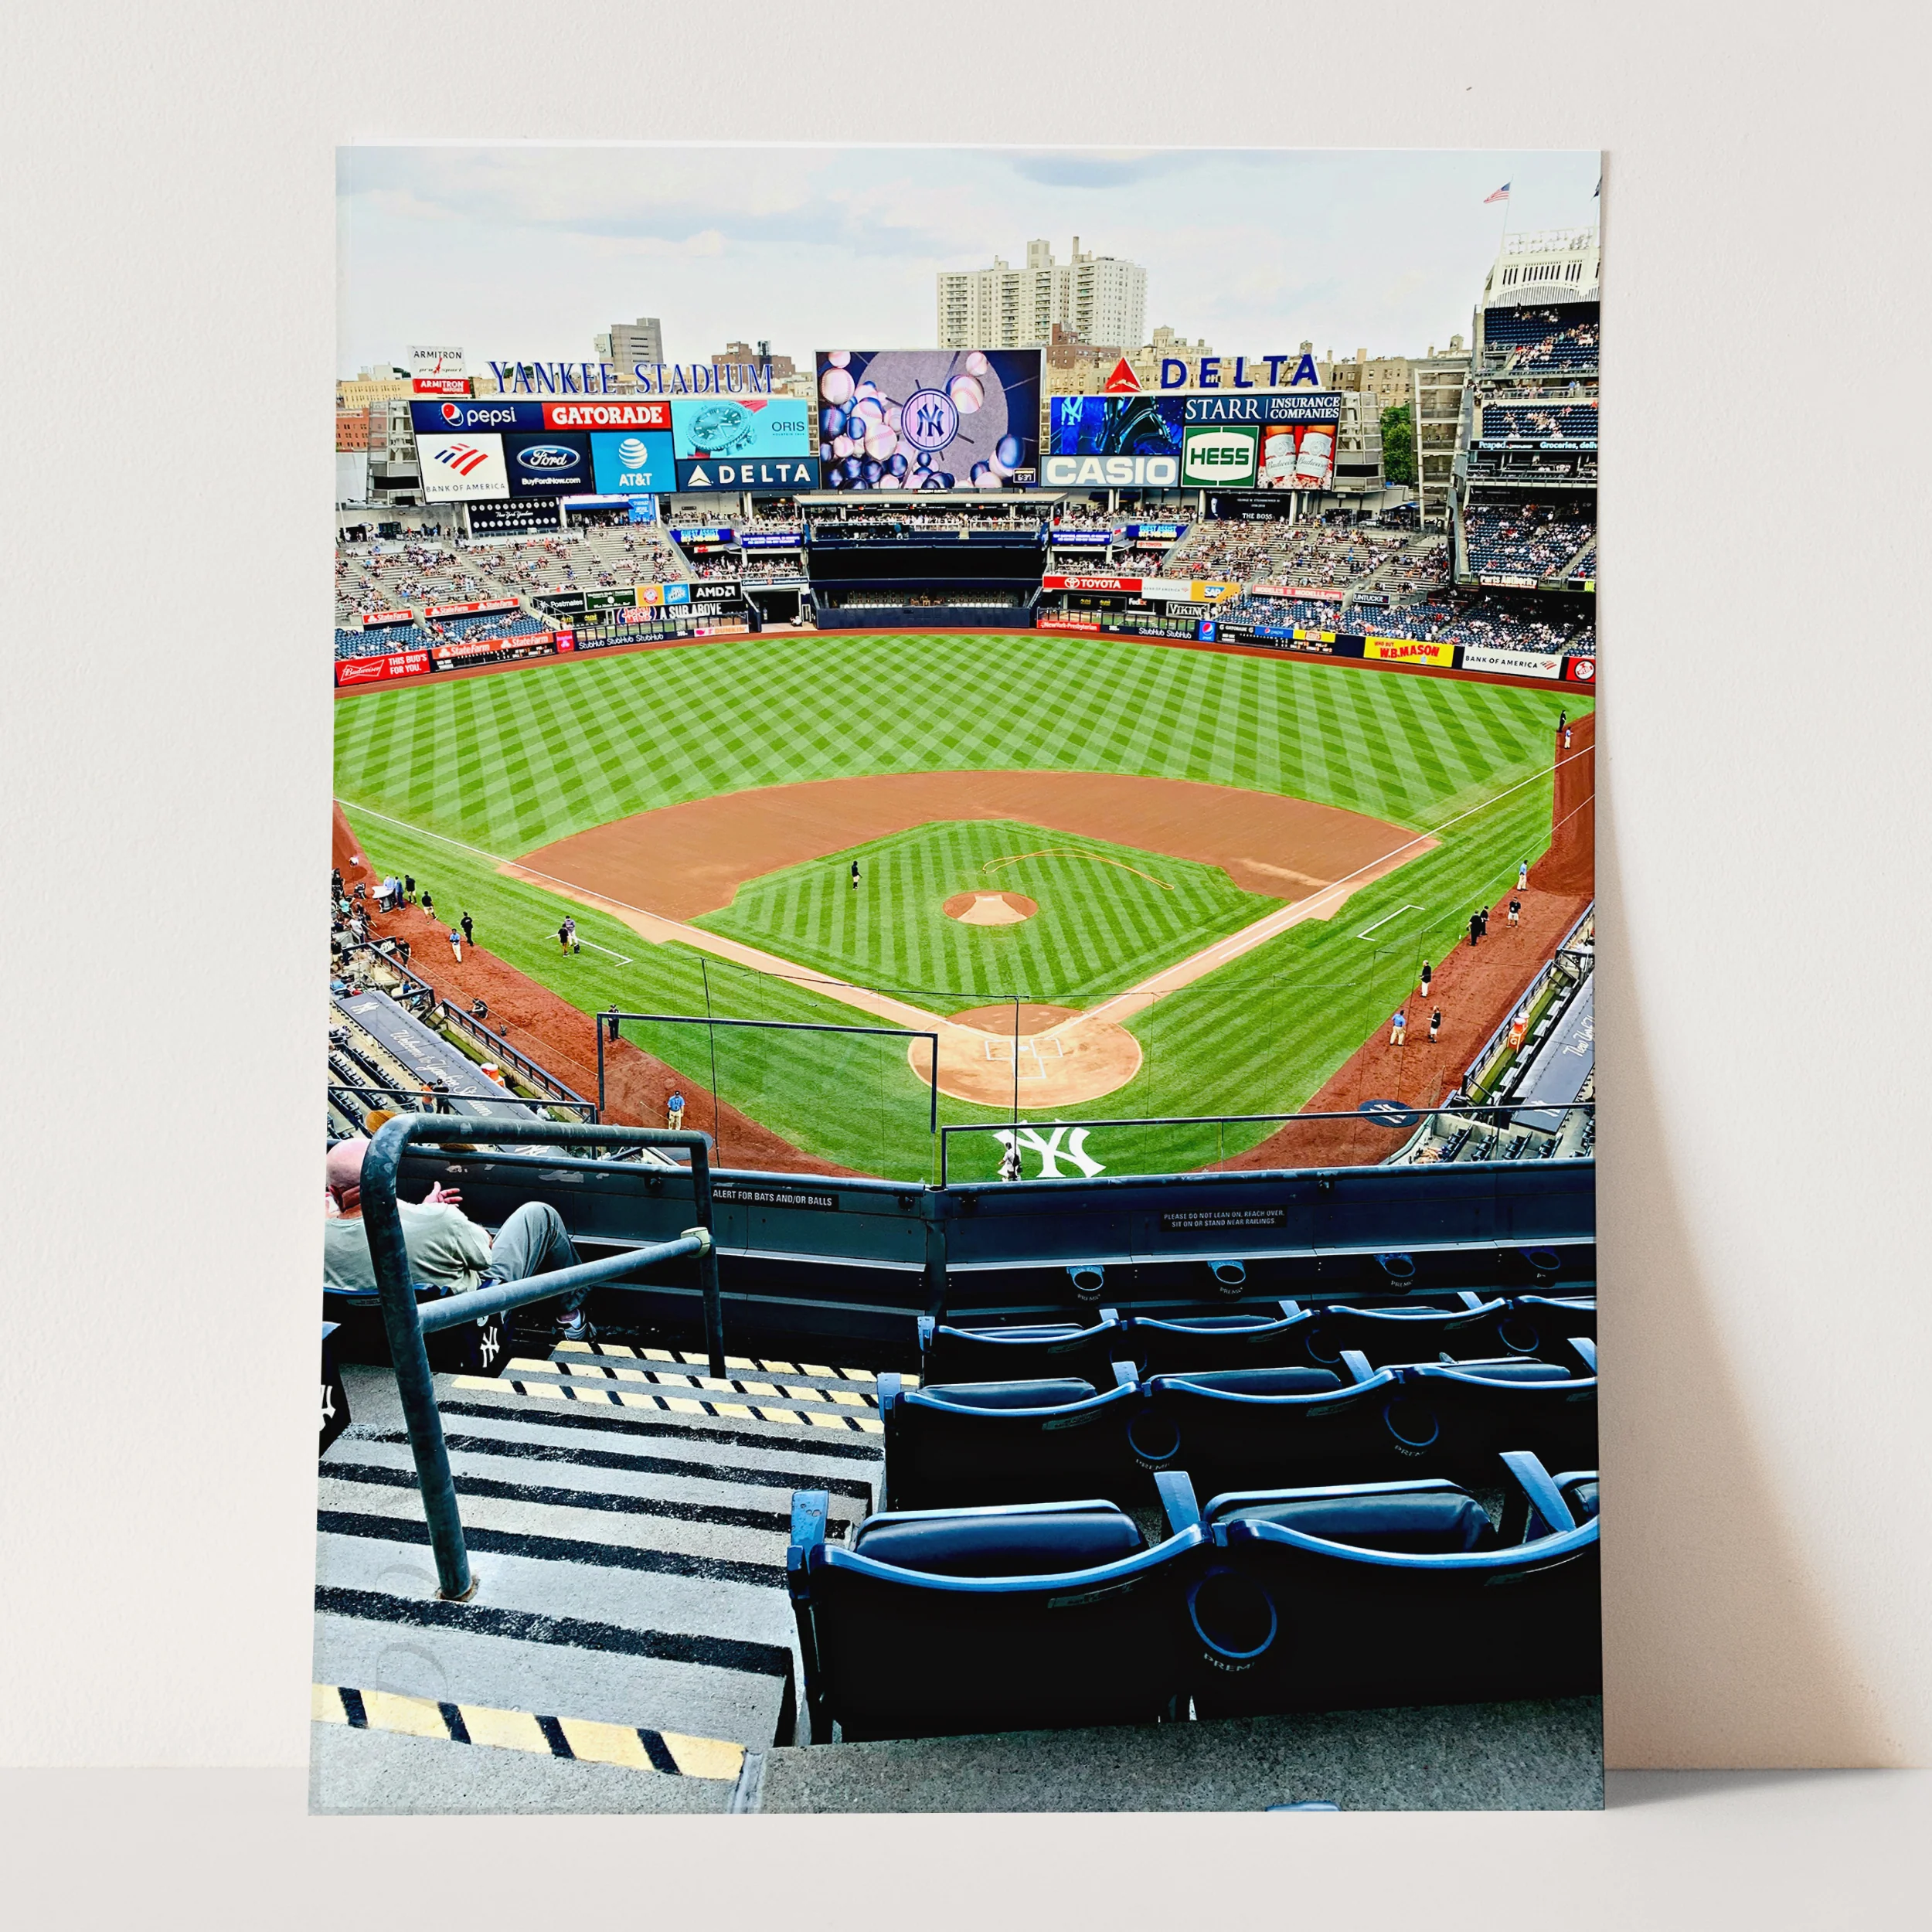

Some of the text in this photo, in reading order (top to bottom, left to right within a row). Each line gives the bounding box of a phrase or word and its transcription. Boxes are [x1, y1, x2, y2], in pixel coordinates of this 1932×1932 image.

[413, 350, 462, 359] ARMITRON
[486, 361, 773, 394] YANKEE STADIUM
[1161, 354, 1322, 389] DELTA
[420, 380, 464, 389] ARMITRON
[1185, 396, 1340, 420] STARR INSURANCE
[1270, 407, 1340, 420] COMPANIES
[467, 406, 517, 426] pepsi
[552, 406, 663, 425] GATORADE
[916, 402, 944, 437] NY
[771, 421, 805, 432] ORIS
[1539, 441, 1578, 450] Groceries,
[530, 448, 567, 466] Ford
[1191, 447, 1249, 465] HESS
[719, 464, 811, 483] DELTA
[1046, 457, 1177, 485] CASIO
[522, 477, 580, 485] BuyFordNow.com
[619, 473, 653, 487] AT&T
[465, 483, 506, 492] AMERICA
[1080, 580, 1121, 589] TOYOTA
[696, 587, 725, 597] AMD
[1204, 587, 1220, 597] SAP
[550, 600, 583, 608] Postmates
[1169, 604, 1206, 617] VIKING
[659, 607, 668, 621] A
[689, 603, 723, 617] ABOVE
[1138, 628, 1192, 639] StubHub StubHub
[579, 633, 664, 649] StubHub StubHub StubHub
[388, 654, 427, 665] THIS BUD'S
[1501, 659, 1538, 668] AMERICA
[344, 666, 380, 677] Budweiser
[390, 665, 403, 675] FOR
[713, 1189, 832, 1206] ALERT FOR BATS AND/OR BALLS
